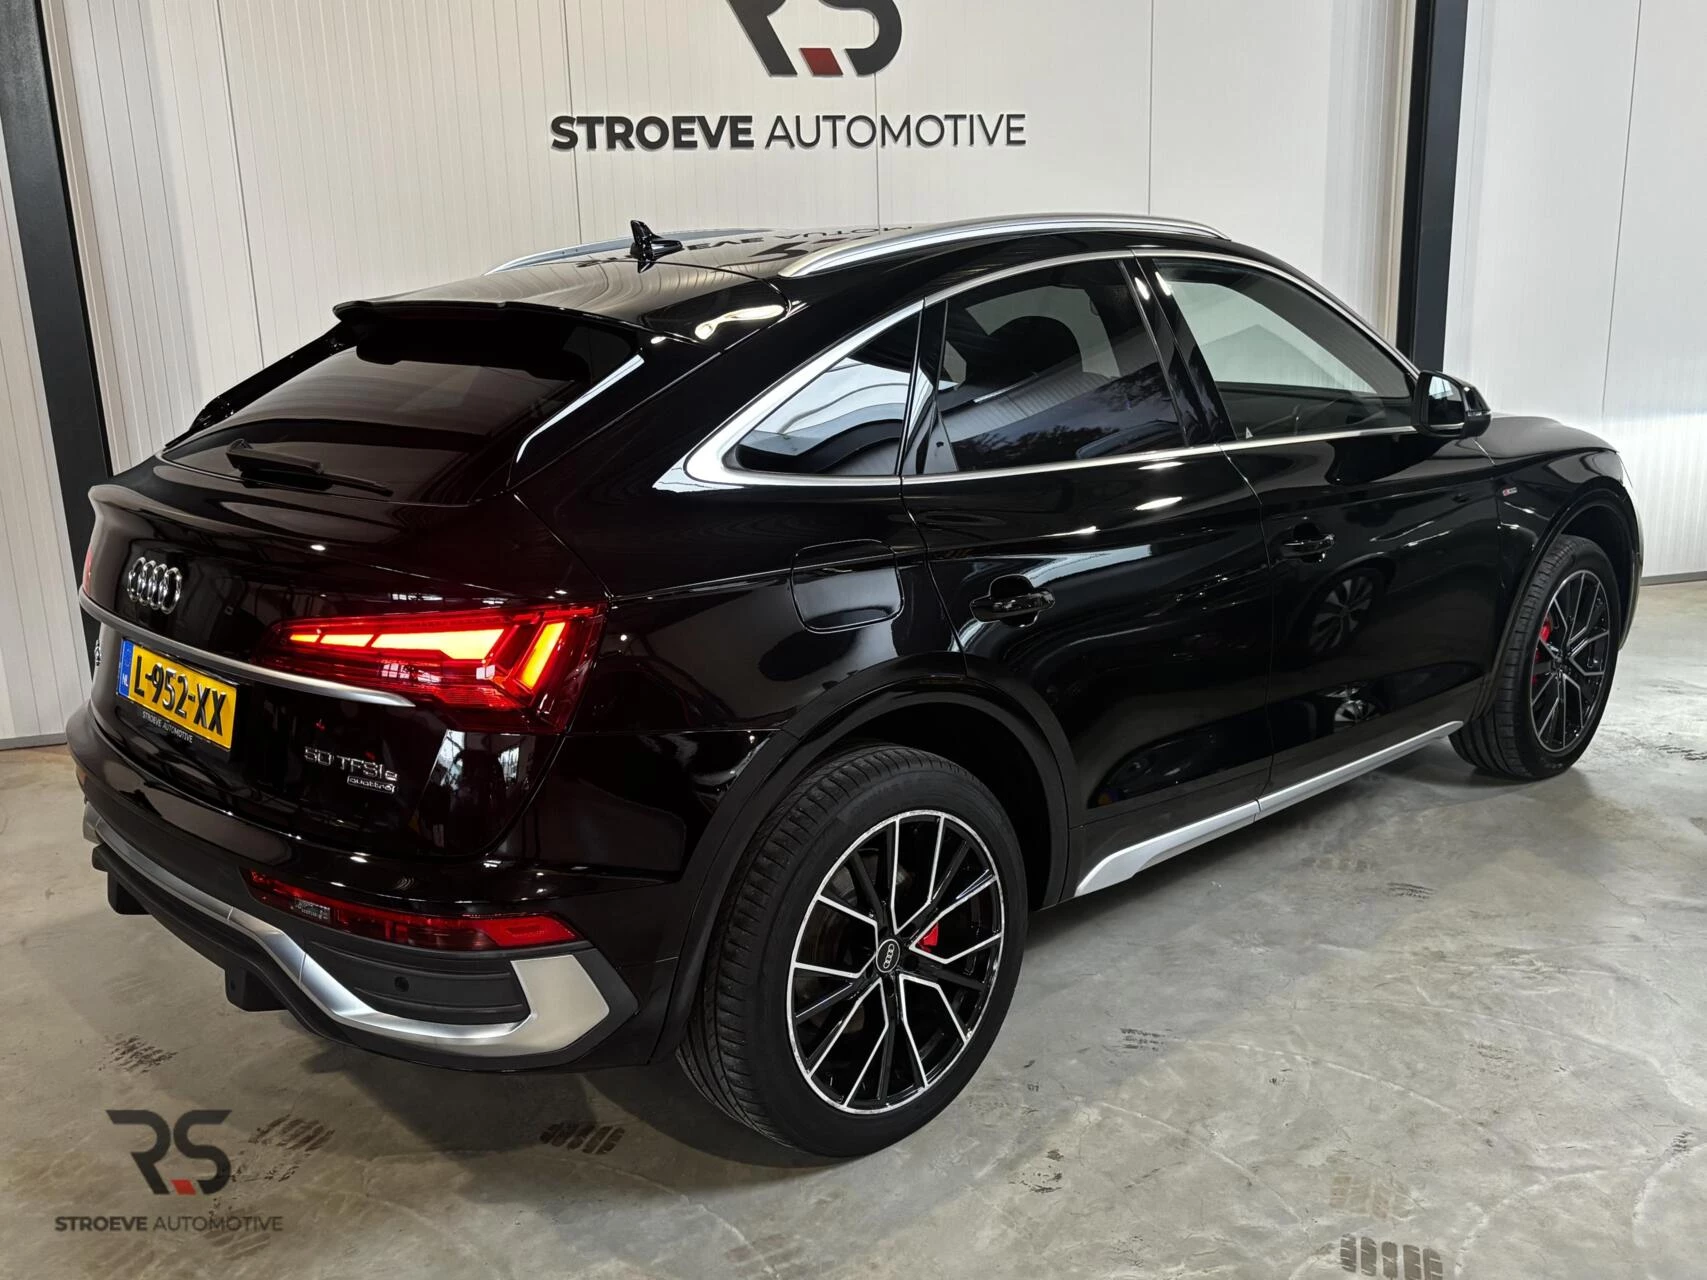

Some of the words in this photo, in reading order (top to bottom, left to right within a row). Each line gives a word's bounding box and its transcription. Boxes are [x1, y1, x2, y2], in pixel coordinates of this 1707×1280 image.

[550, 115, 754, 150] STROEVE
[765, 113, 1026, 148] AUTOMOTIVE
[134, 655, 226, 736] L-952-XX
[162, 723, 193, 743] AUTOMOTIVE
[304, 746, 332, 766] 50
